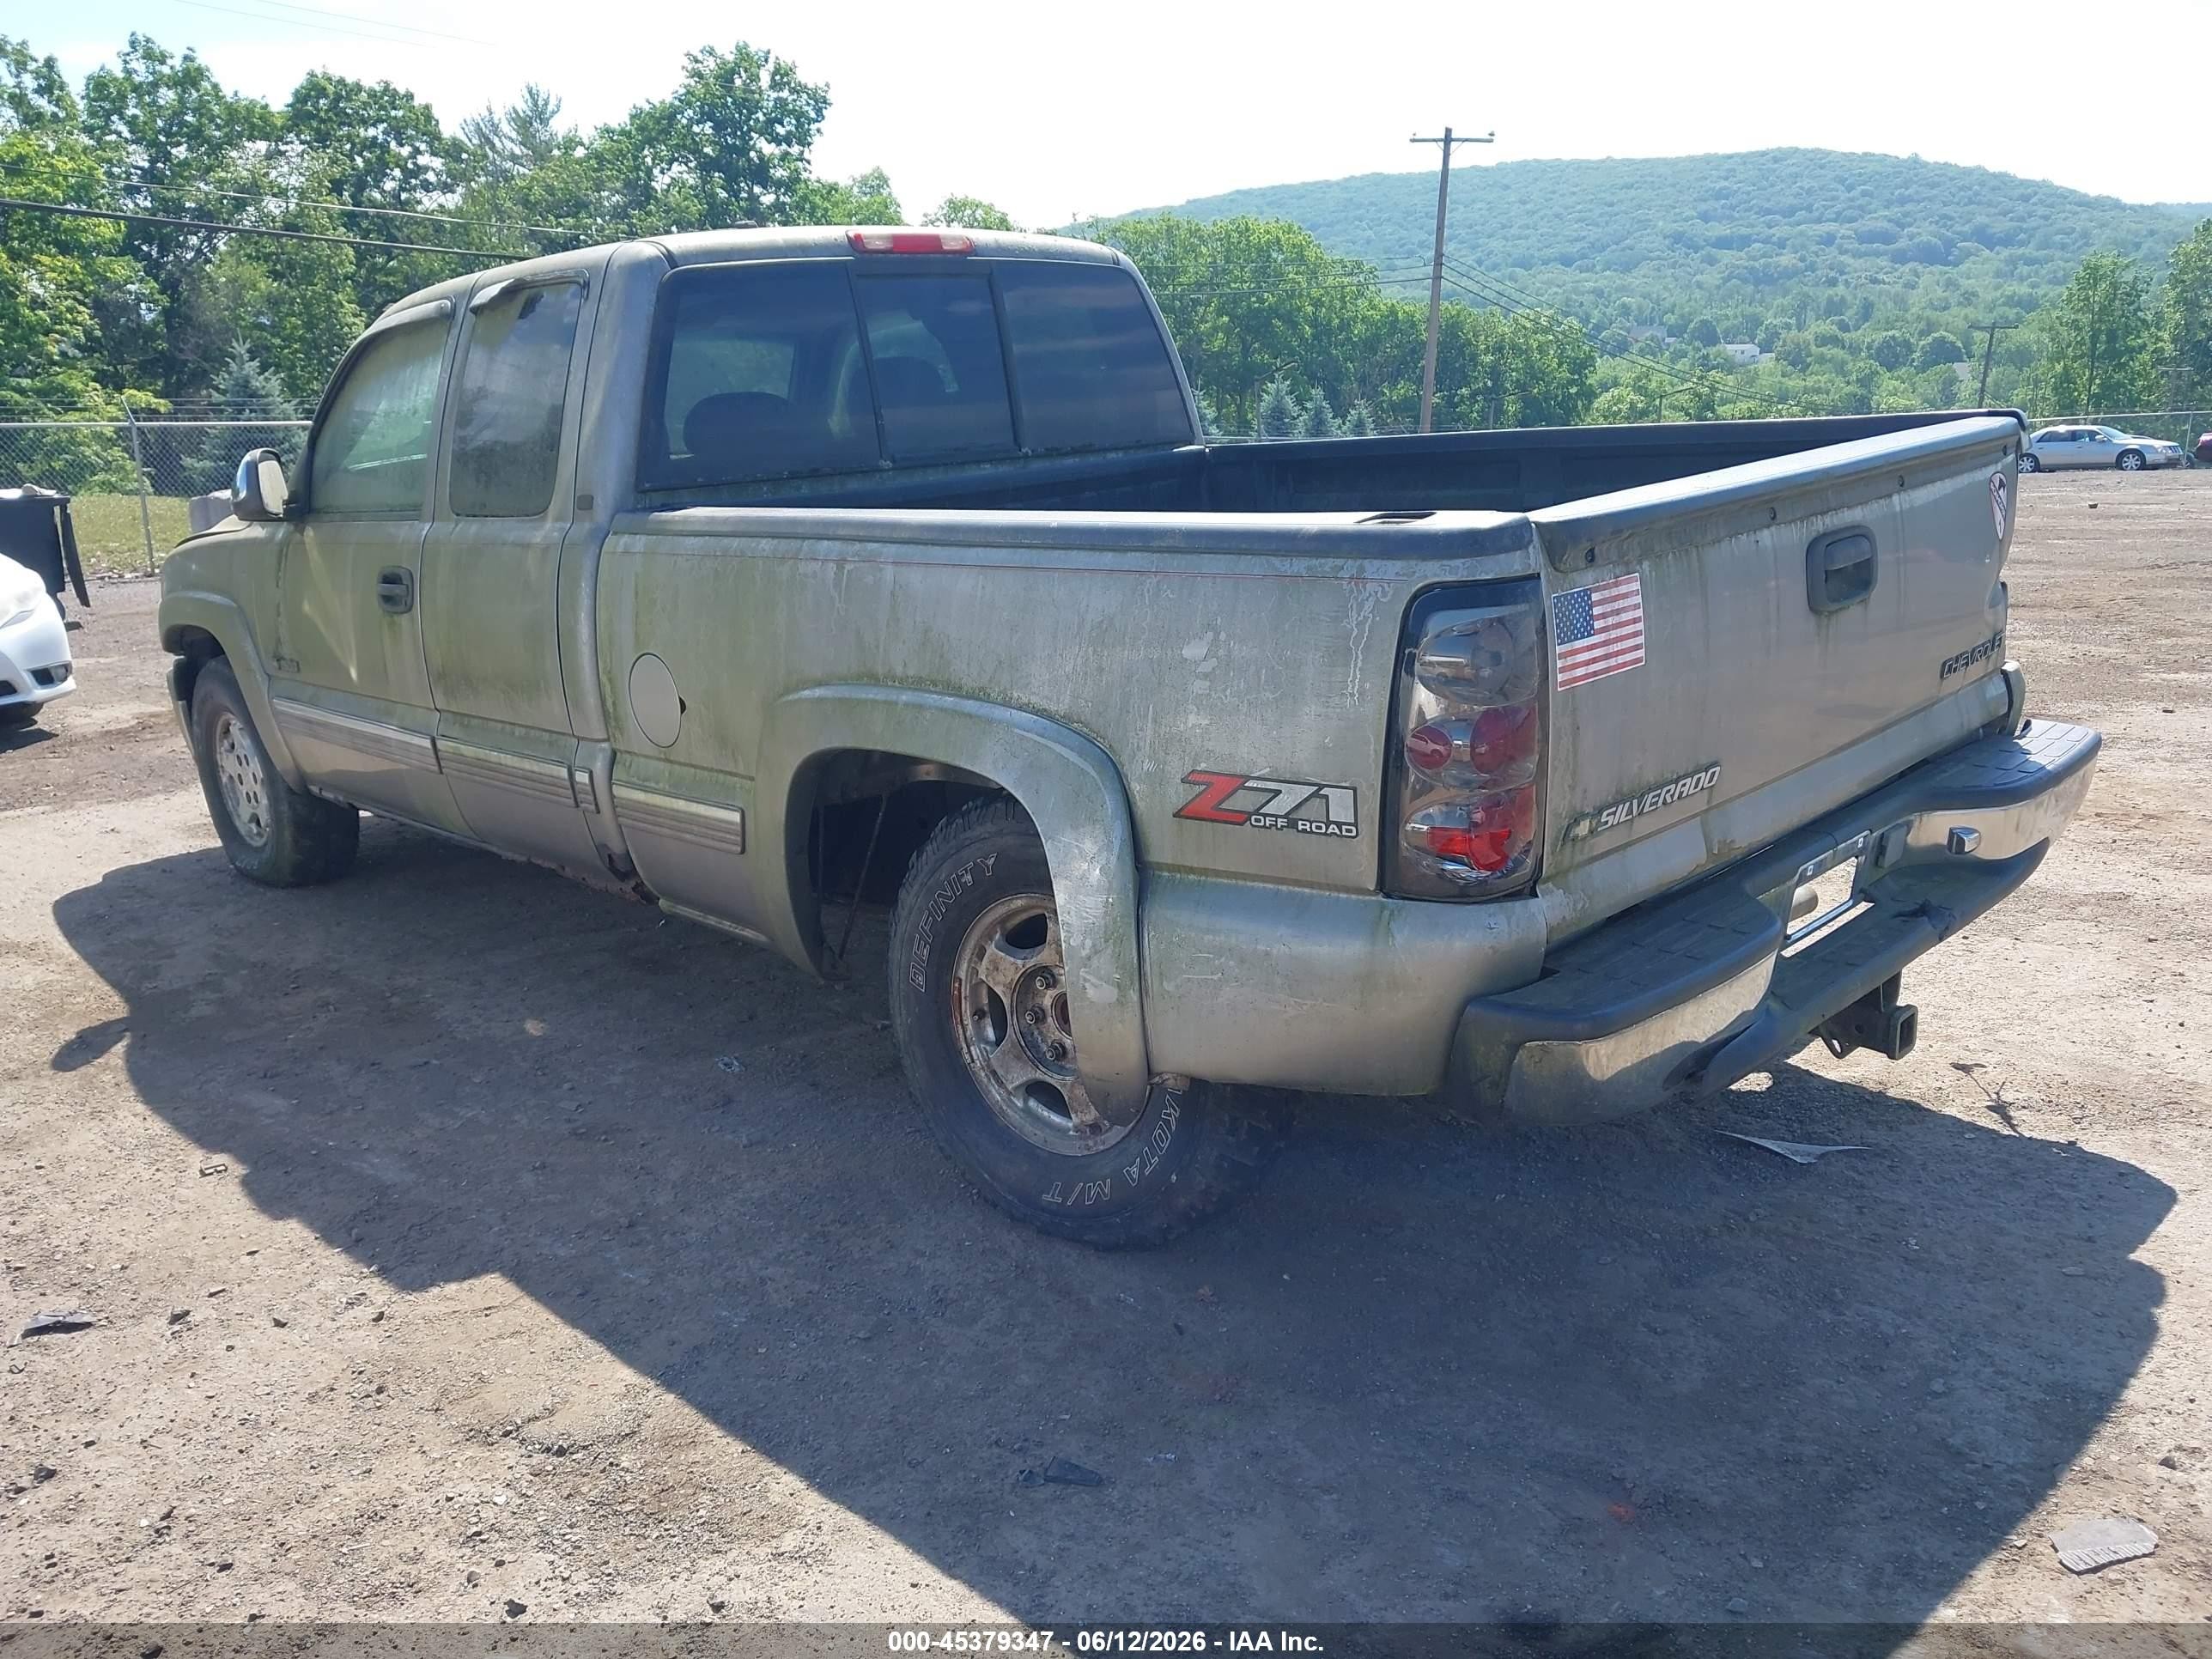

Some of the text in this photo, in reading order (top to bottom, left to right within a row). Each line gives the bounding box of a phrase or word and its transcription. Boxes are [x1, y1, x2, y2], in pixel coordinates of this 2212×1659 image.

[1173, 770, 1358, 826] Z71
[1250, 815, 1357, 837] OFF ROAD
[1598, 766, 1721, 831] SILVERADO
[909, 853, 998, 993] DEFINITY
[1042, 1088, 1182, 1206] KOTA M/T
